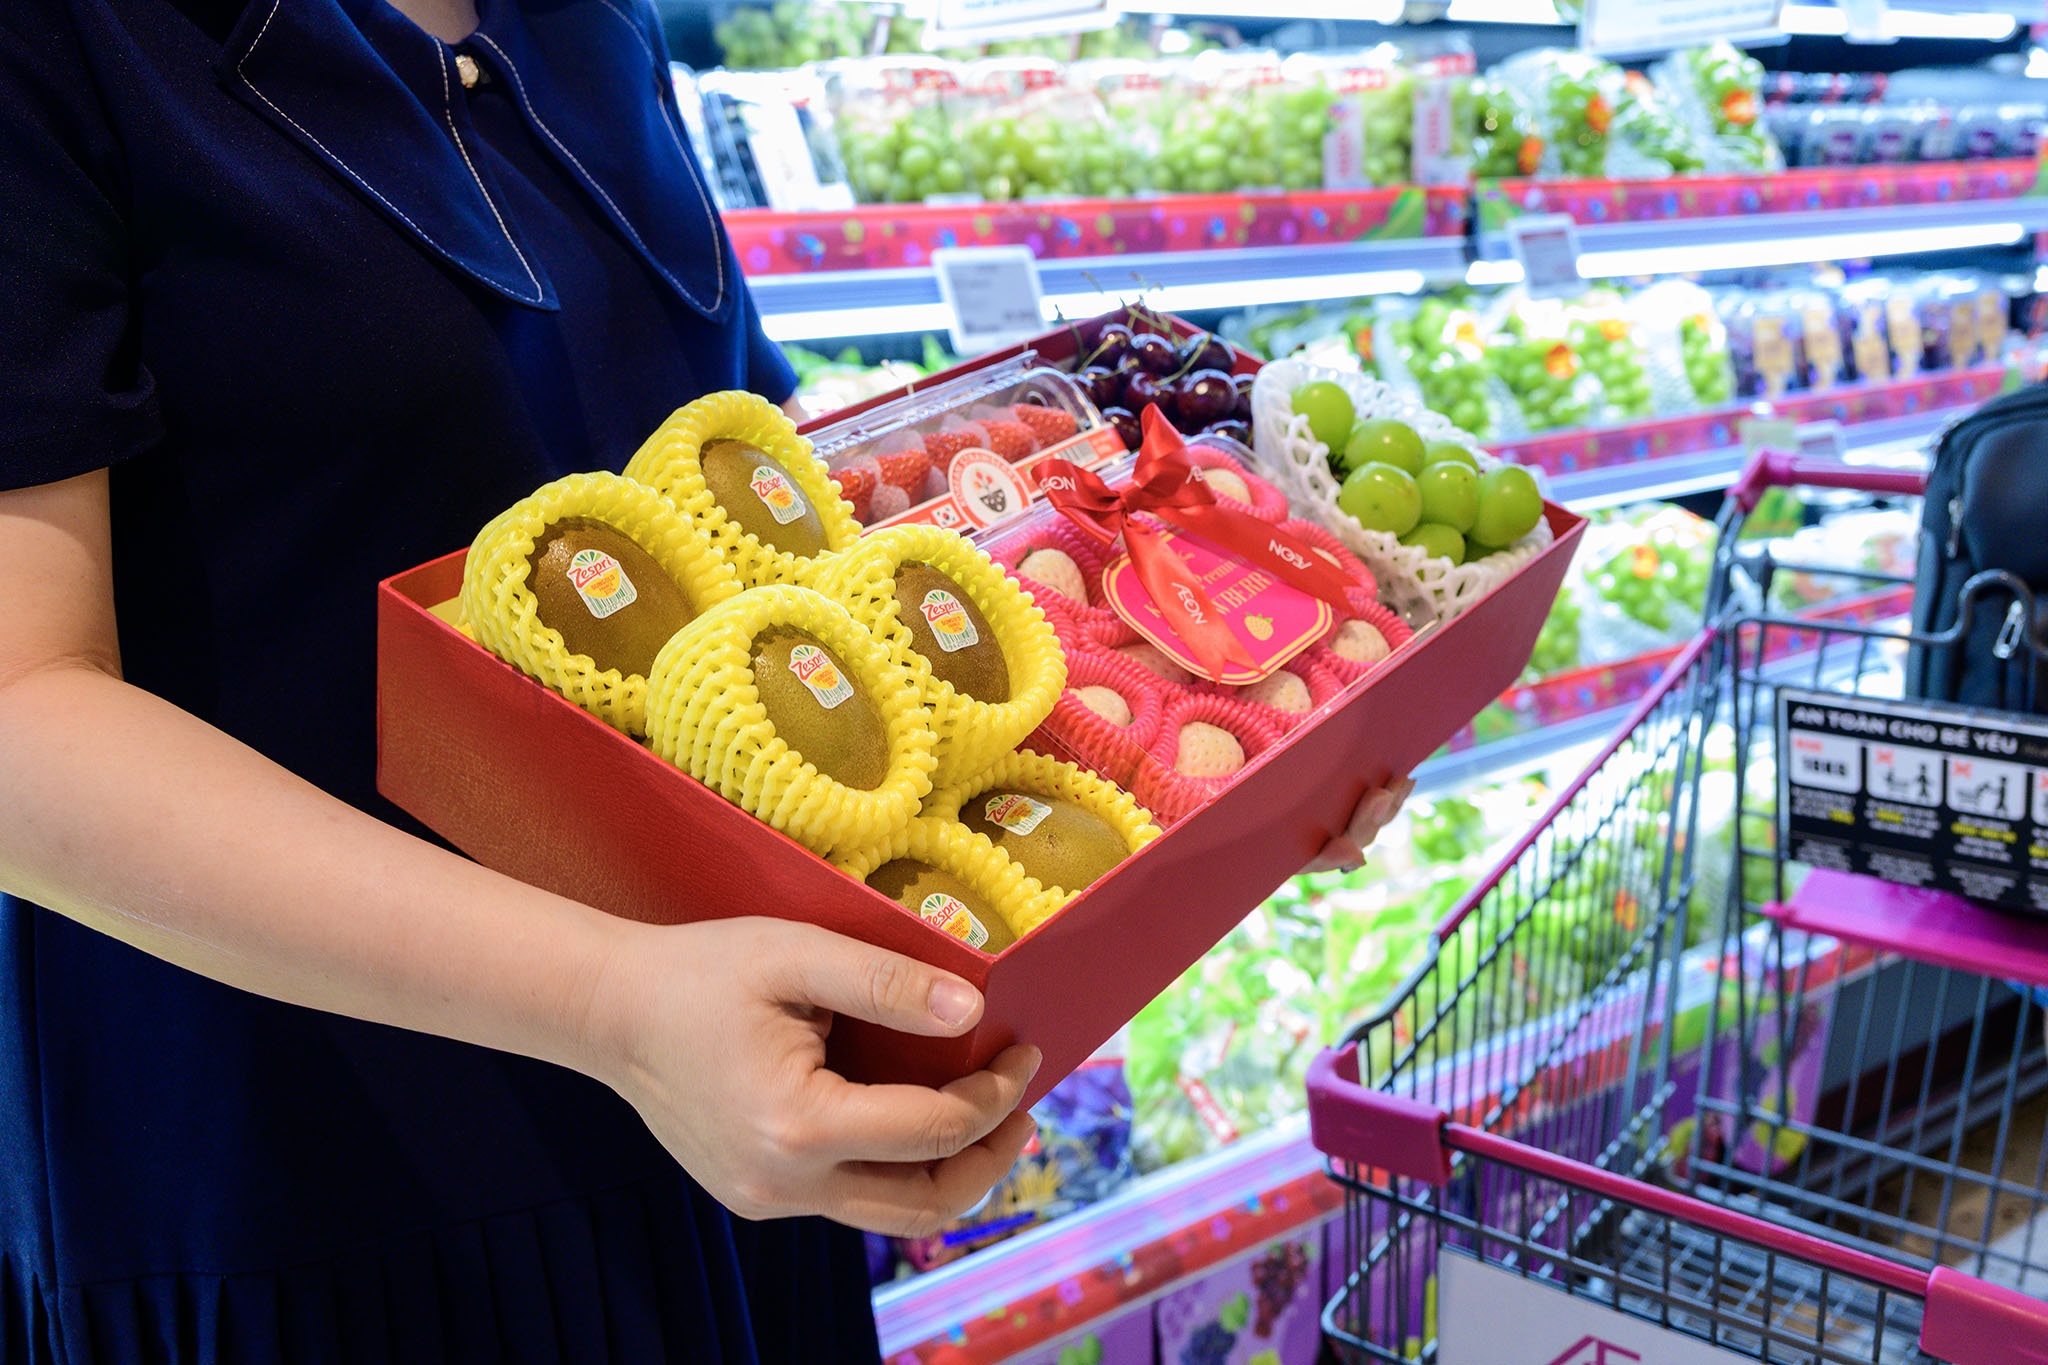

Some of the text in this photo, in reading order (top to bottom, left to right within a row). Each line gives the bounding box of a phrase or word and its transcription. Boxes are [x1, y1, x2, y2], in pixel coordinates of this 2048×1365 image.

[568, 556, 615, 588] Zespri
[922, 600, 960, 622] Zespri
[791, 650, 827, 681] Zespri
[1792, 706, 1825, 727] AN
[1889, 720, 1938, 744] CHO
